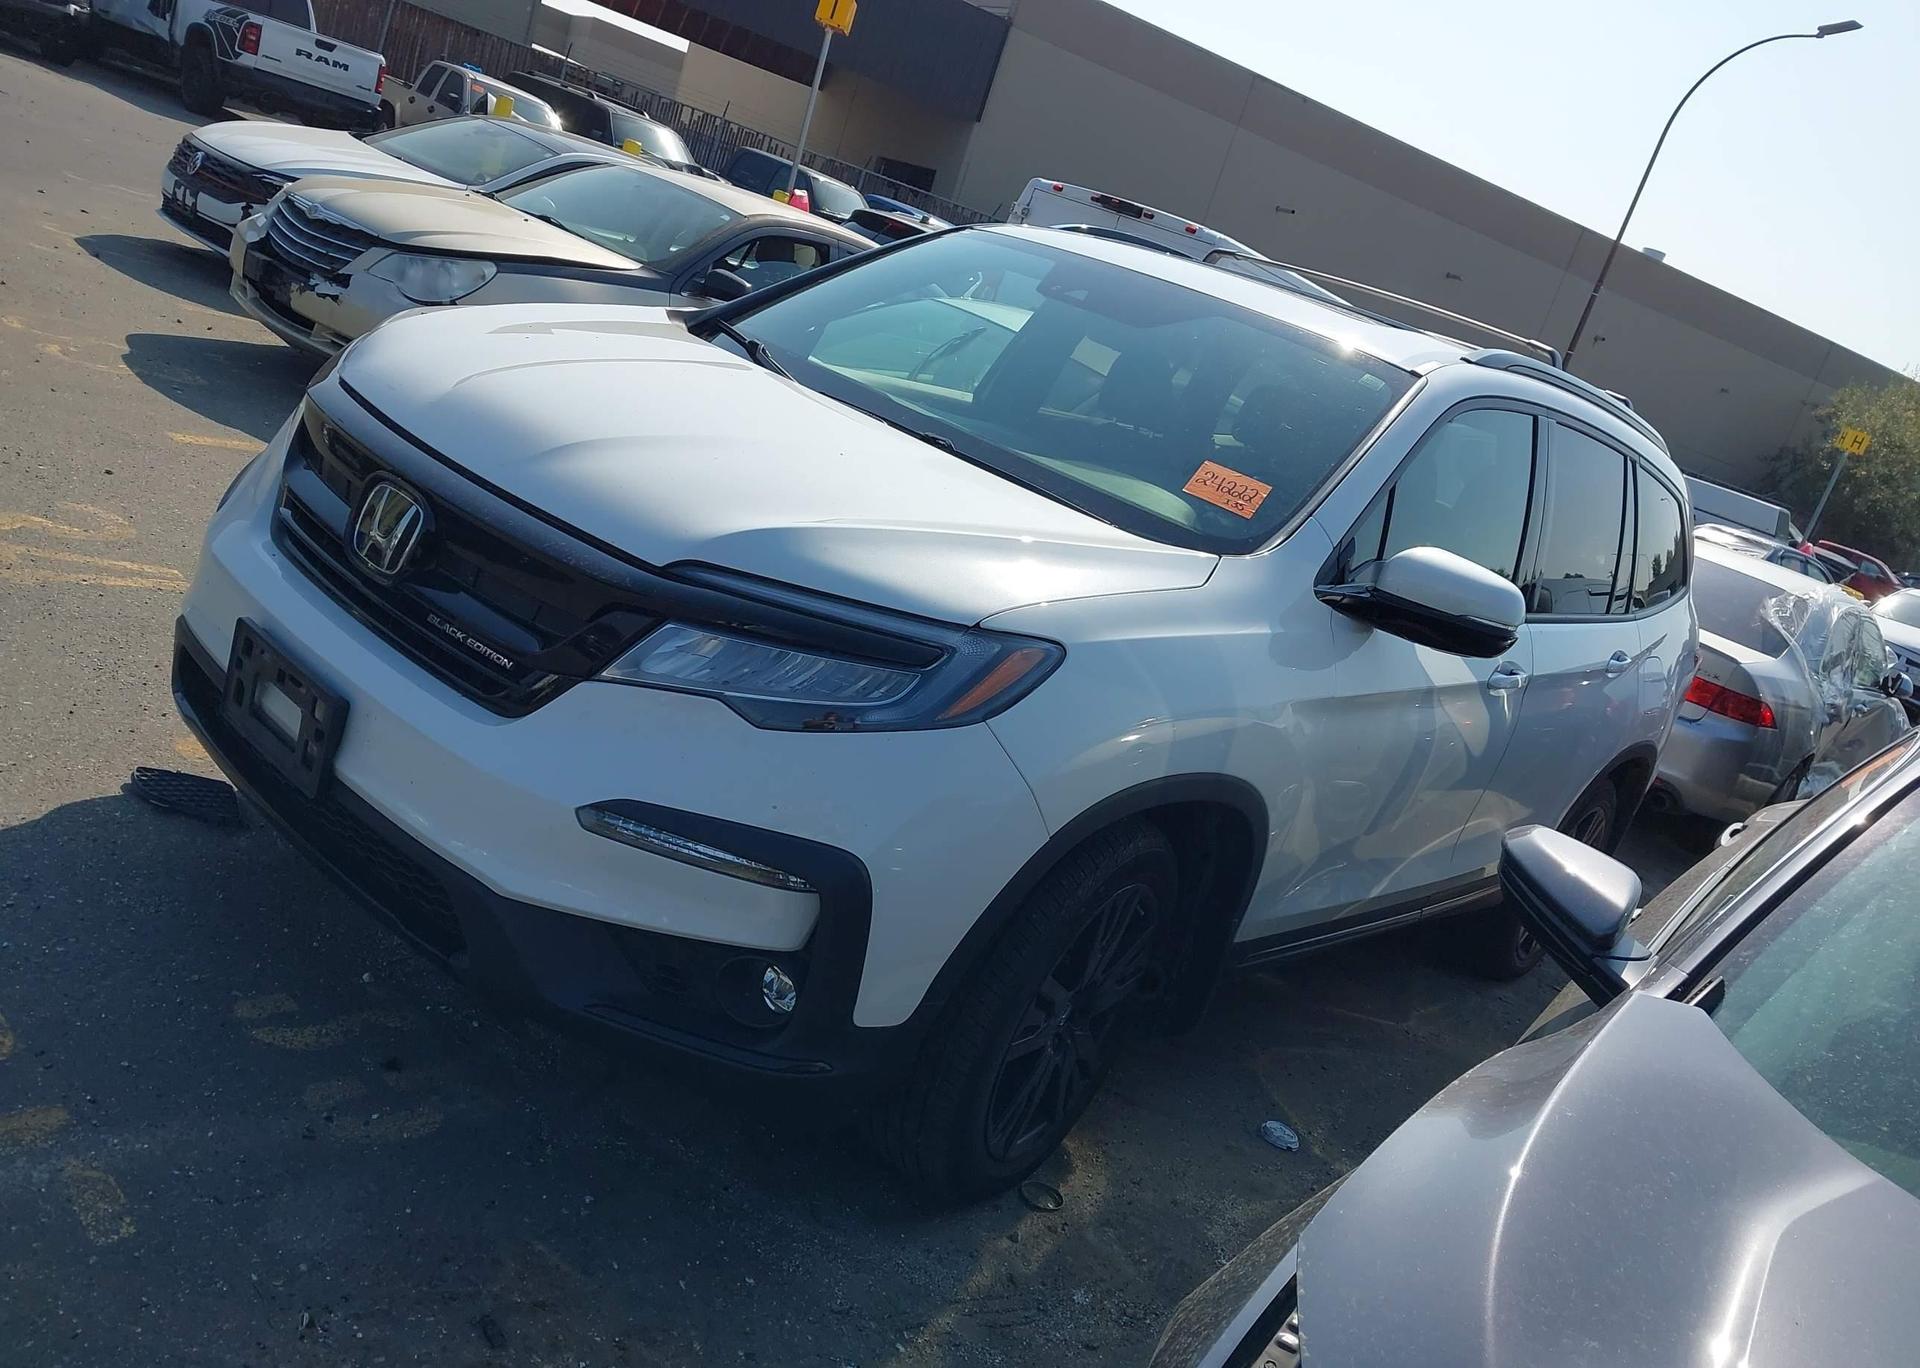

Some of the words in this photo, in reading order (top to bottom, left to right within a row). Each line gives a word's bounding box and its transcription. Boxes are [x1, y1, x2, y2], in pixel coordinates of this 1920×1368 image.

[295, 48, 350, 72] RAM
[1850, 434, 1865, 450] H
[1195, 471, 1259, 503] 24222
[426, 613, 467, 642] BLACK
[466, 638, 514, 670] EDITION
